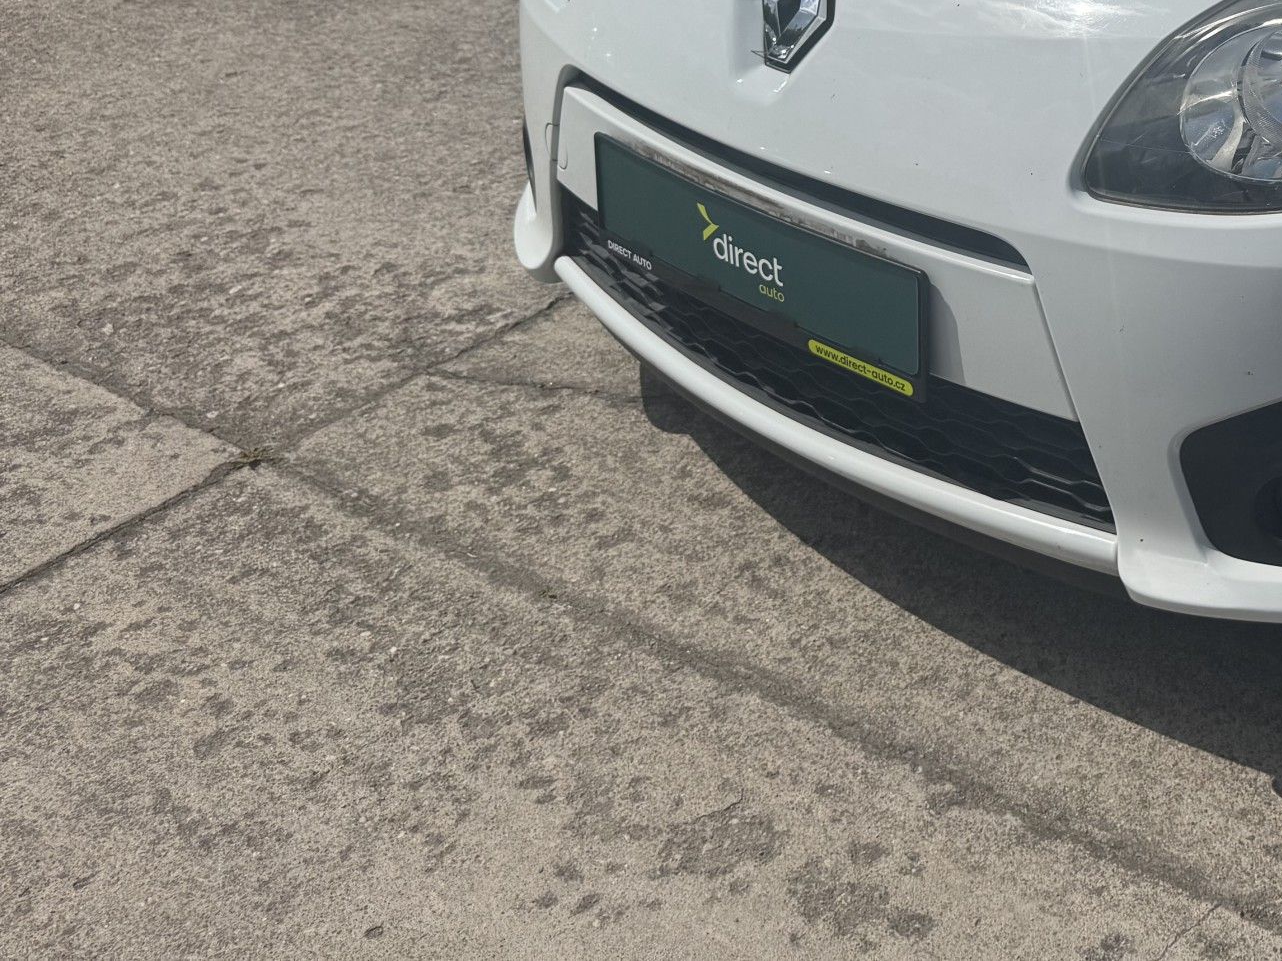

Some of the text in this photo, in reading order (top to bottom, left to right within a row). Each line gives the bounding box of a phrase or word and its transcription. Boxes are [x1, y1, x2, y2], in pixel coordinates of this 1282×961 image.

[607, 239, 653, 271] DIRECT AUTO
[712, 233, 784, 287] direct
[759, 283, 785, 303] auto
[814, 344, 906, 392] www.direct-auto.cz
